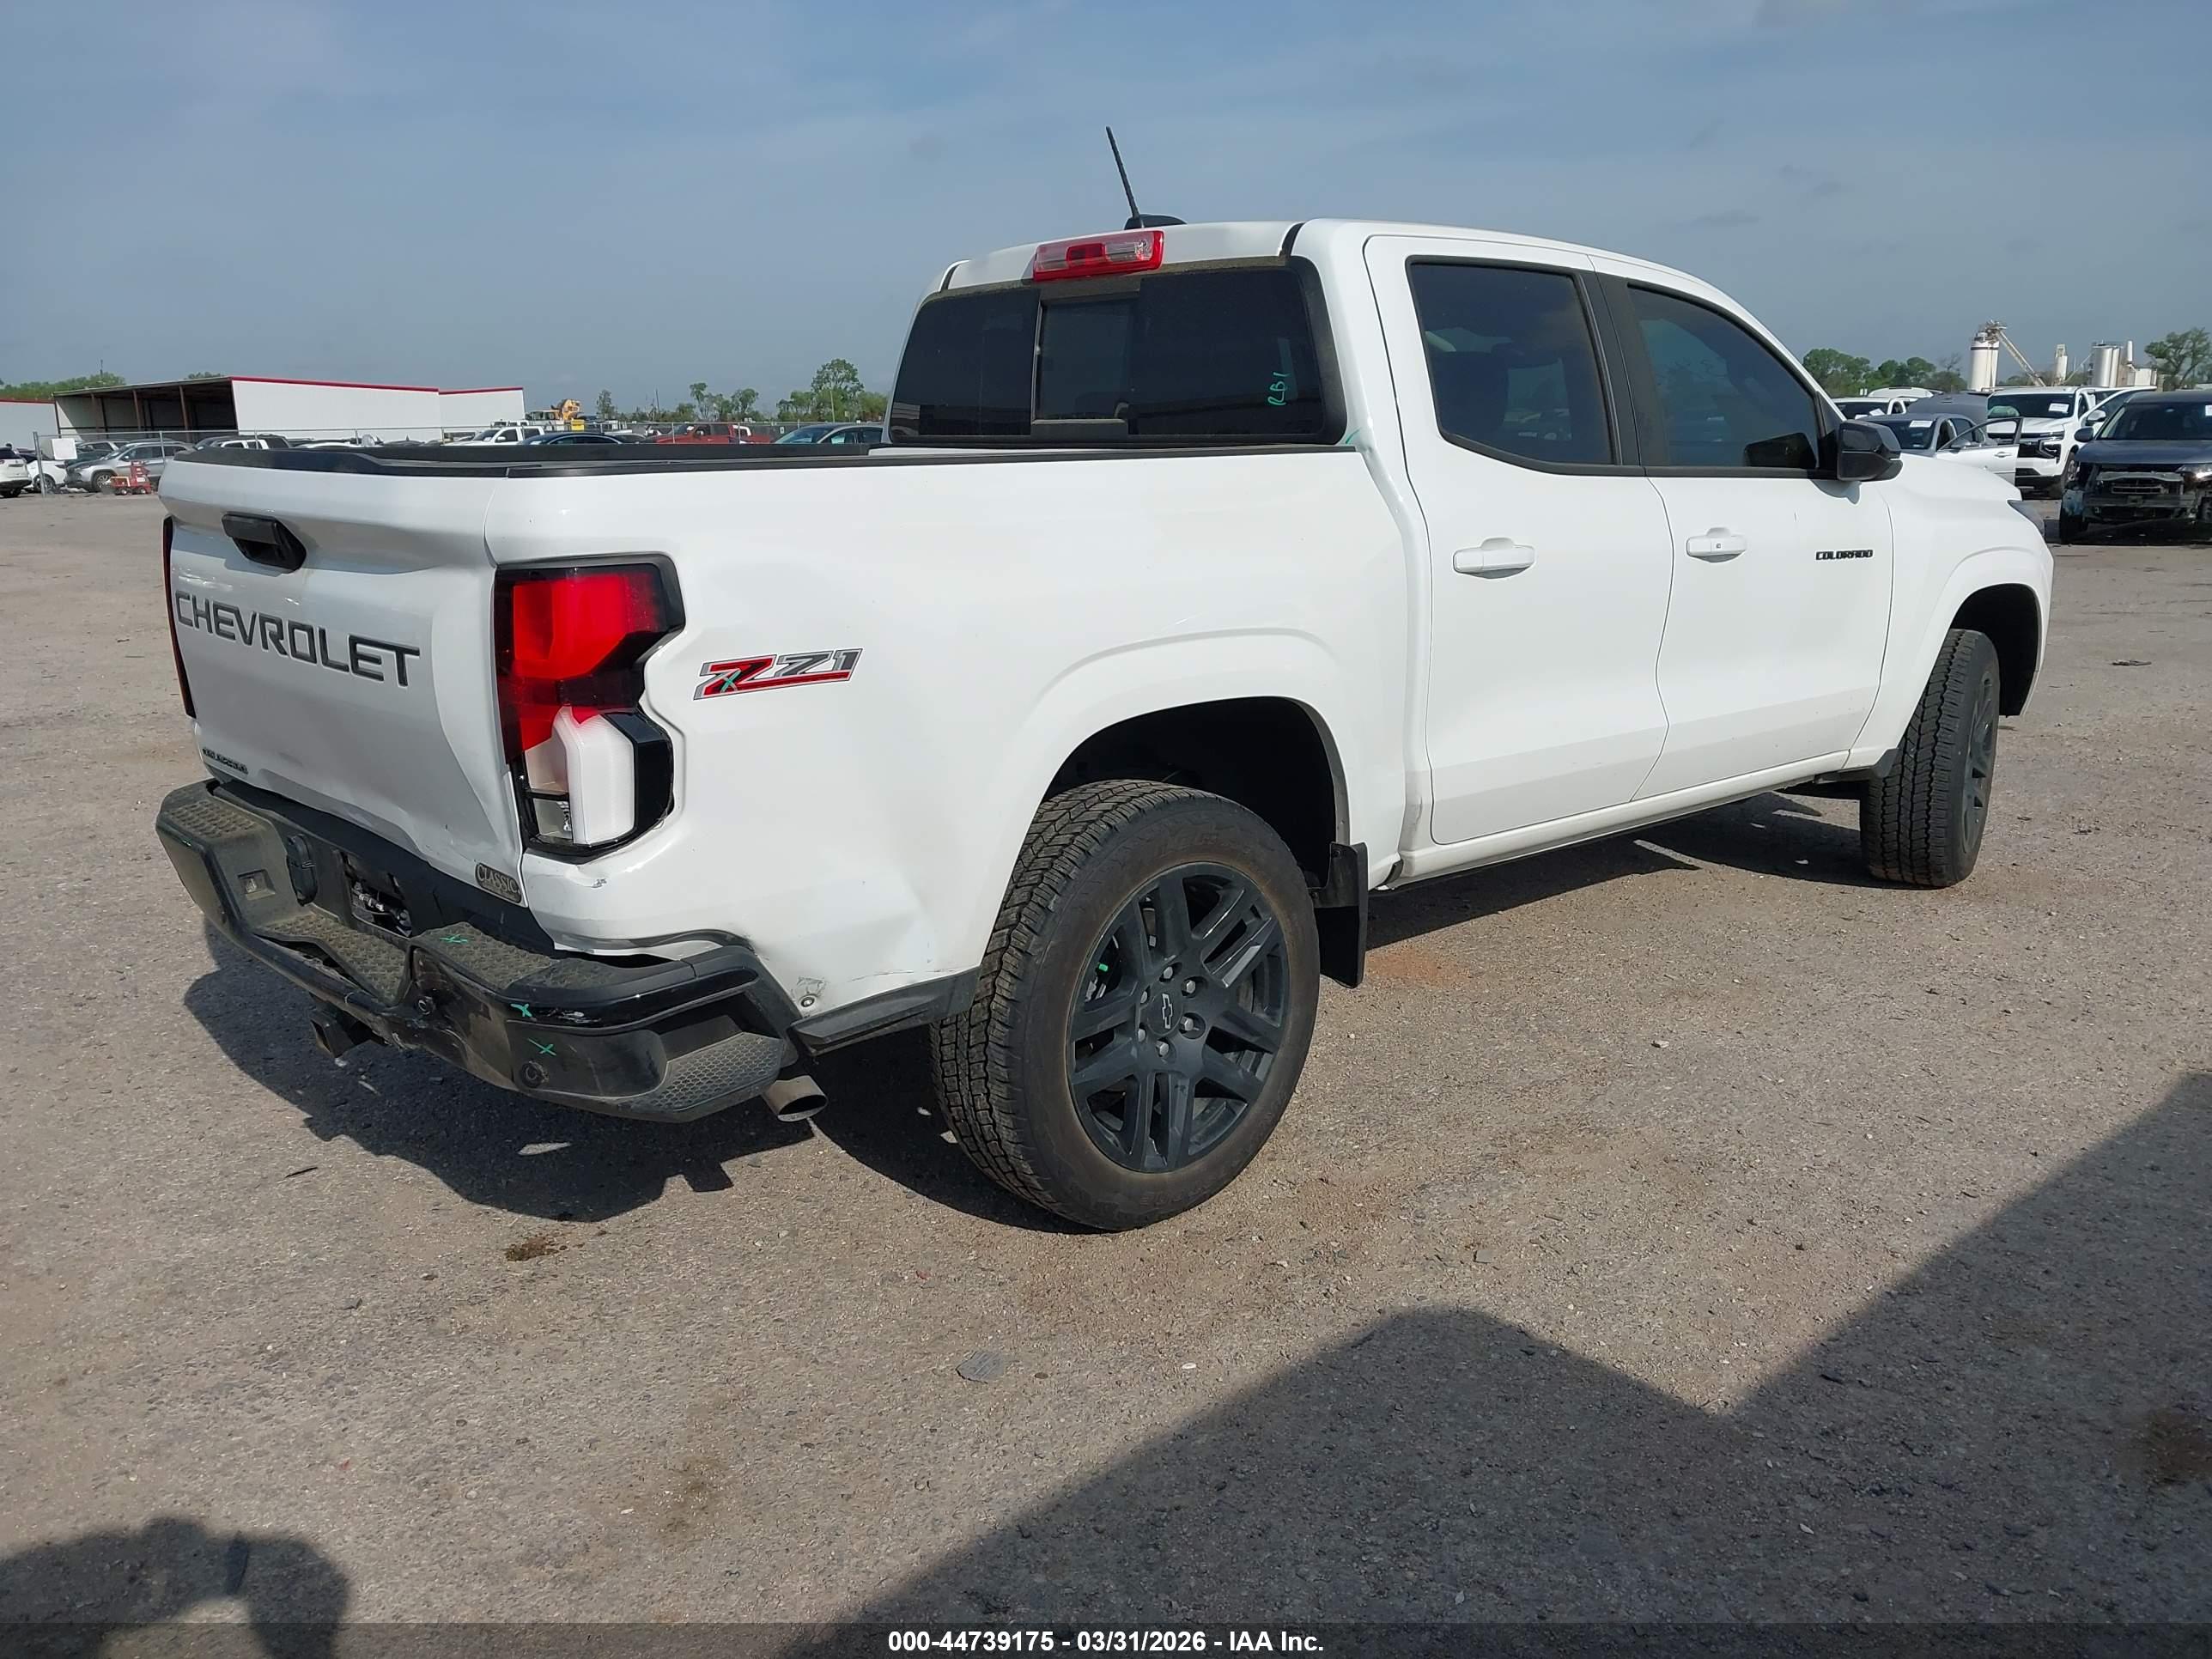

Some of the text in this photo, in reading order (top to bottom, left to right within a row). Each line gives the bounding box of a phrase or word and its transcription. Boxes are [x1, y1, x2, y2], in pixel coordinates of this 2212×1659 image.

[1815, 549, 1874, 561] COLORADO
[174, 589, 421, 688] CHEVROLET
[693, 647, 864, 701] Z71
[477, 864, 518, 894] CLASSIC
